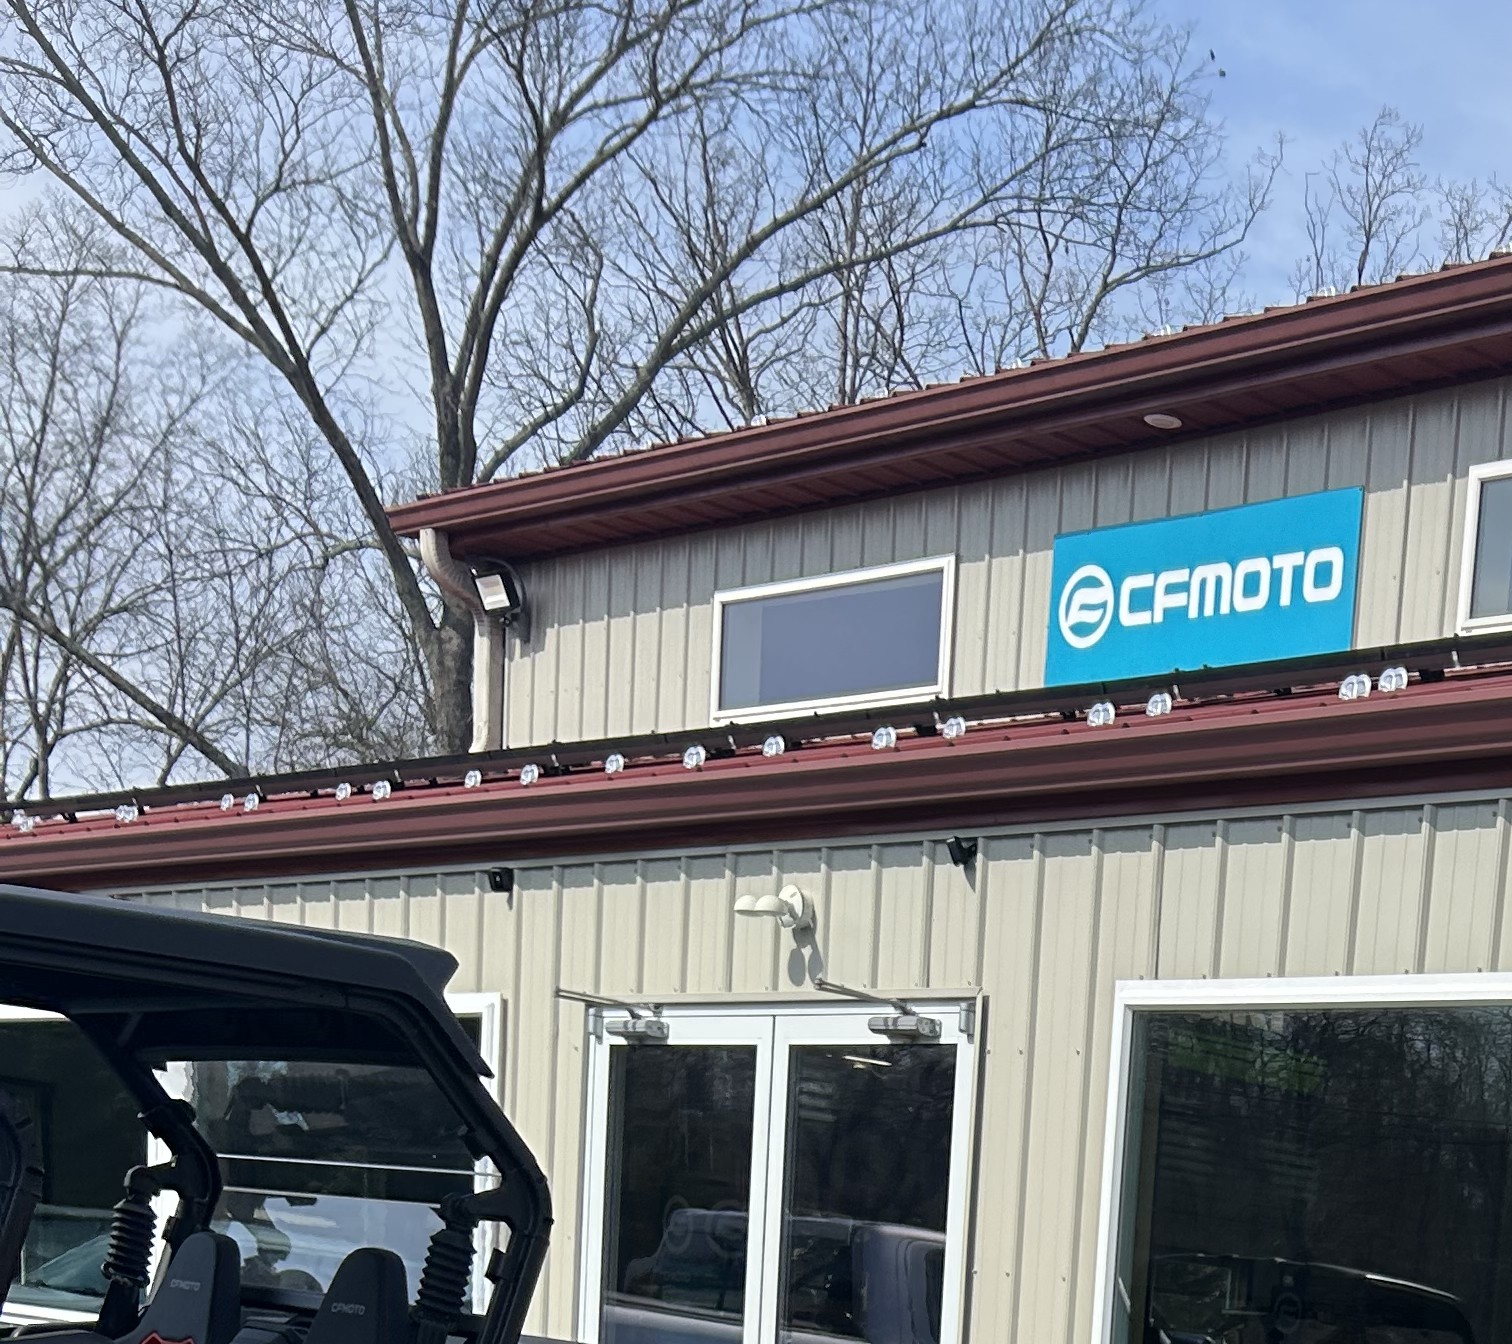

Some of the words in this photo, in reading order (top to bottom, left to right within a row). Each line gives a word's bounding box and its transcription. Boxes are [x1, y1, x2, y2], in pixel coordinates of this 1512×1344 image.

[1118, 546, 1345, 627] CFMOTO
[170, 1278, 201, 1292] CFMOTO
[331, 1302, 366, 1316] CFMOTO
